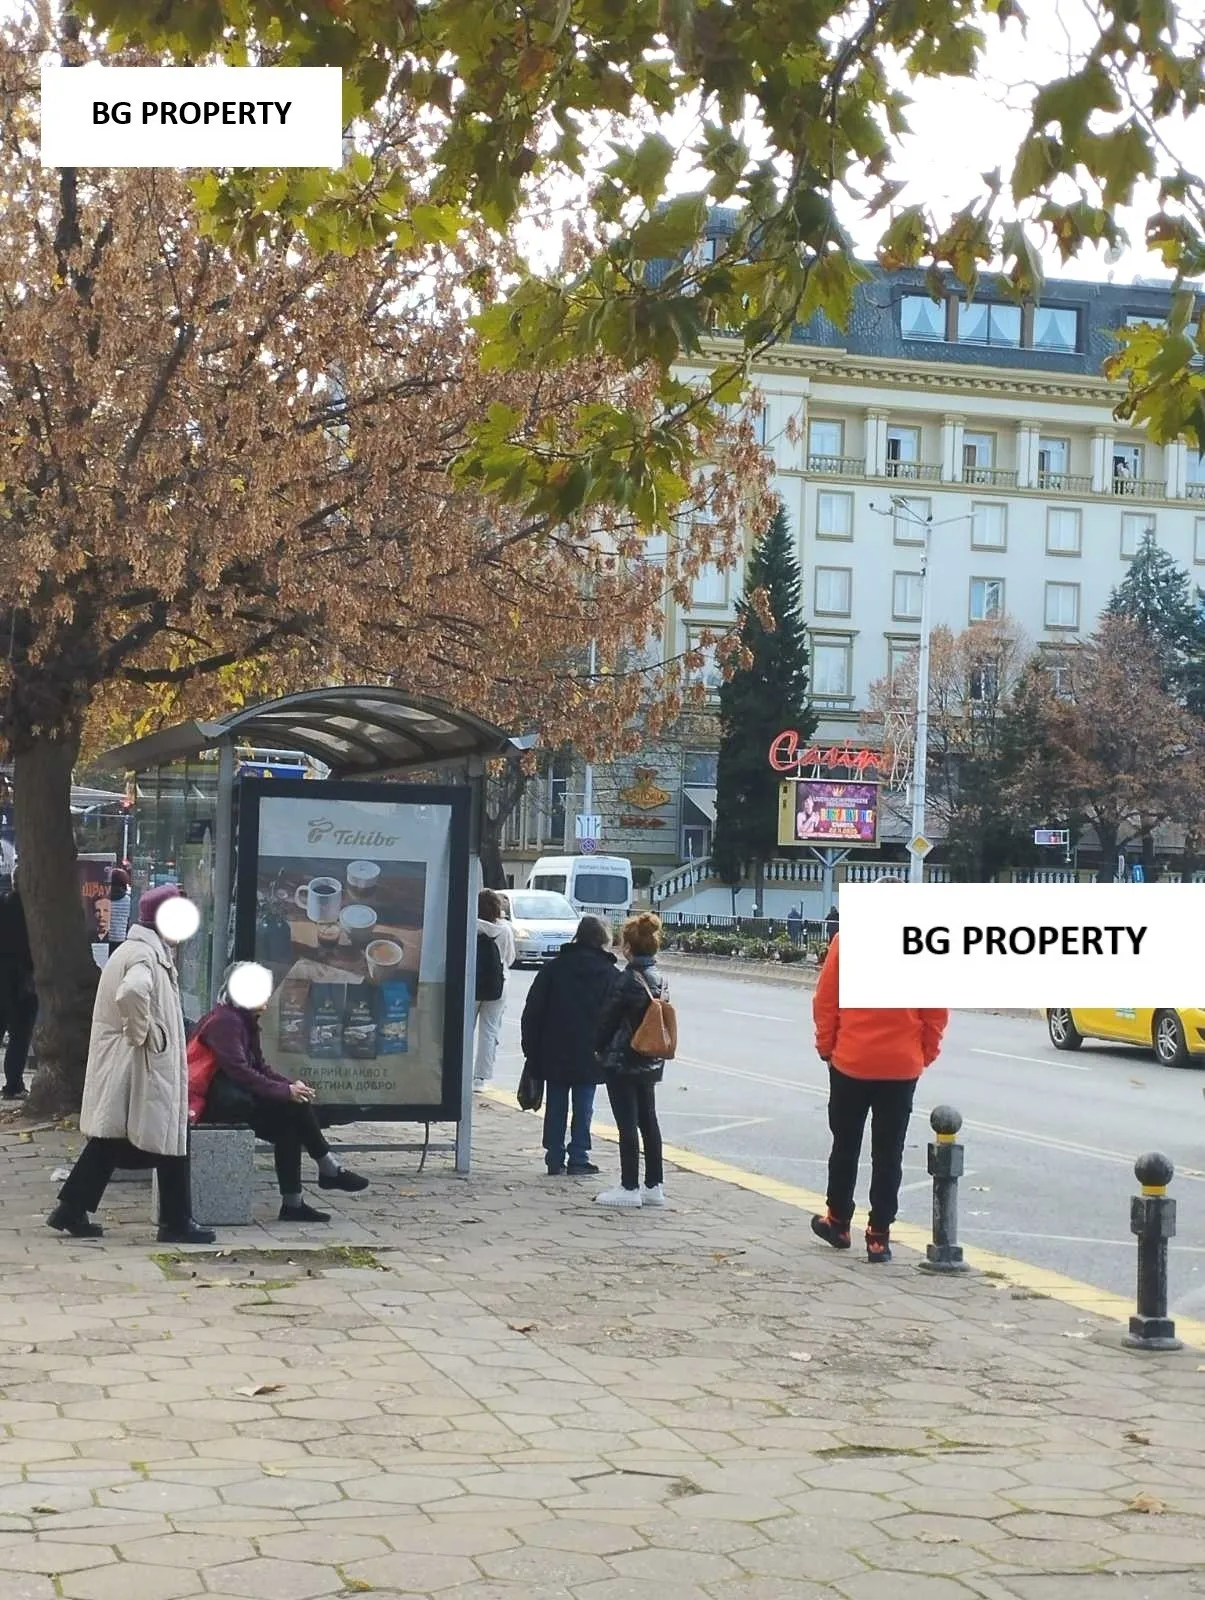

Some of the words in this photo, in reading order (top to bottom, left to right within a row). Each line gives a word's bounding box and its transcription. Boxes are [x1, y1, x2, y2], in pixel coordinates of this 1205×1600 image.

[769, 730, 881, 771] Casin
[333, 829, 401, 847] Tchibo
[306, 1080, 353, 1090] ИСТИНА
